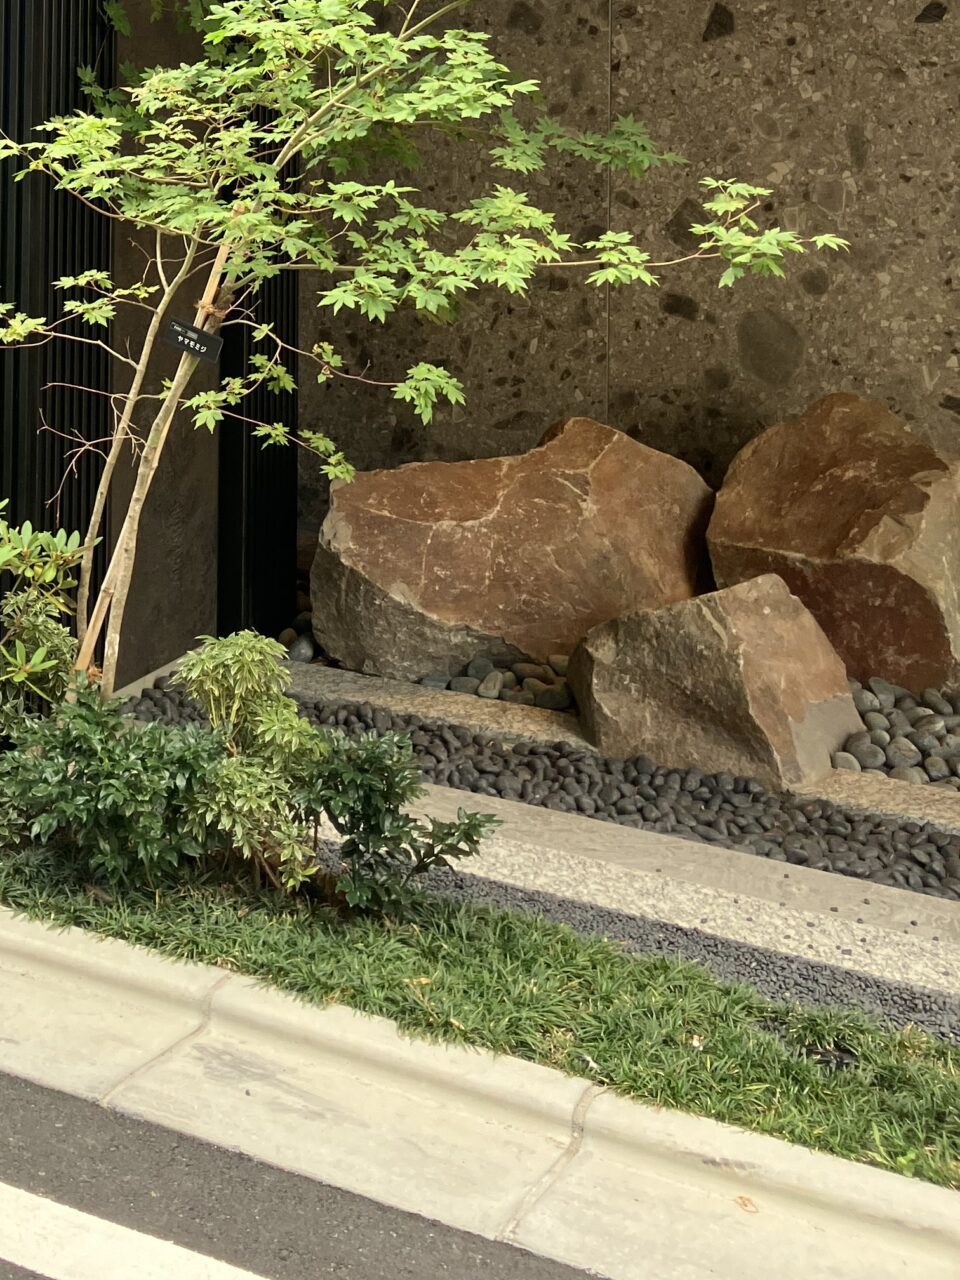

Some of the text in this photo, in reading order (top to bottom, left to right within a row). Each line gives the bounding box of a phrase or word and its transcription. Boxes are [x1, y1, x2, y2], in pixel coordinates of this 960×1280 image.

[177, 335, 207, 353] ヤマモミジ
